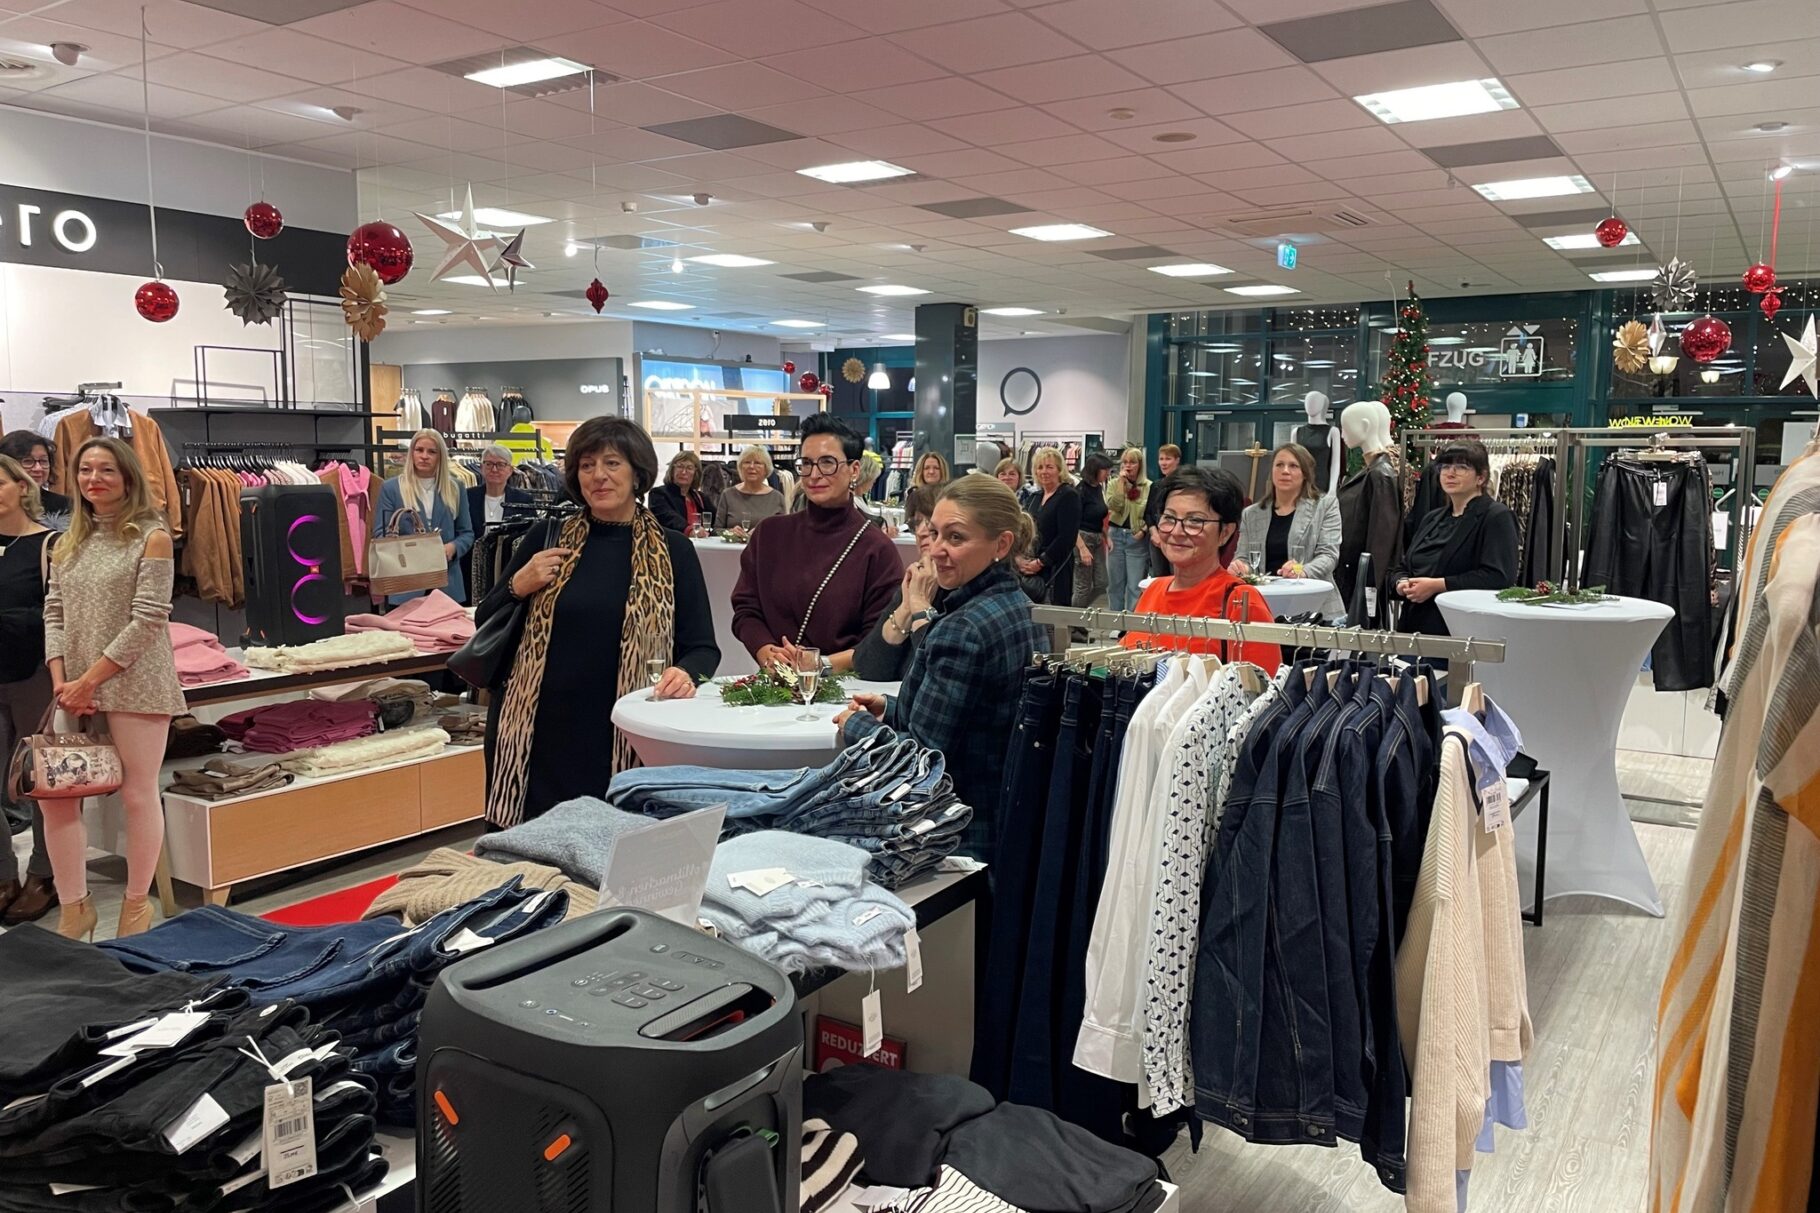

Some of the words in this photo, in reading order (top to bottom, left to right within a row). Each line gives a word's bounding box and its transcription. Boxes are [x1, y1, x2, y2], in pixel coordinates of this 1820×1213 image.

[0, 204, 97, 253] ro
[1427, 351, 1485, 368] FZUG
[580, 384, 610, 394] OPUS
[443, 432, 485, 440] bugatti
[821, 1030, 898, 1067] REDUZERT
